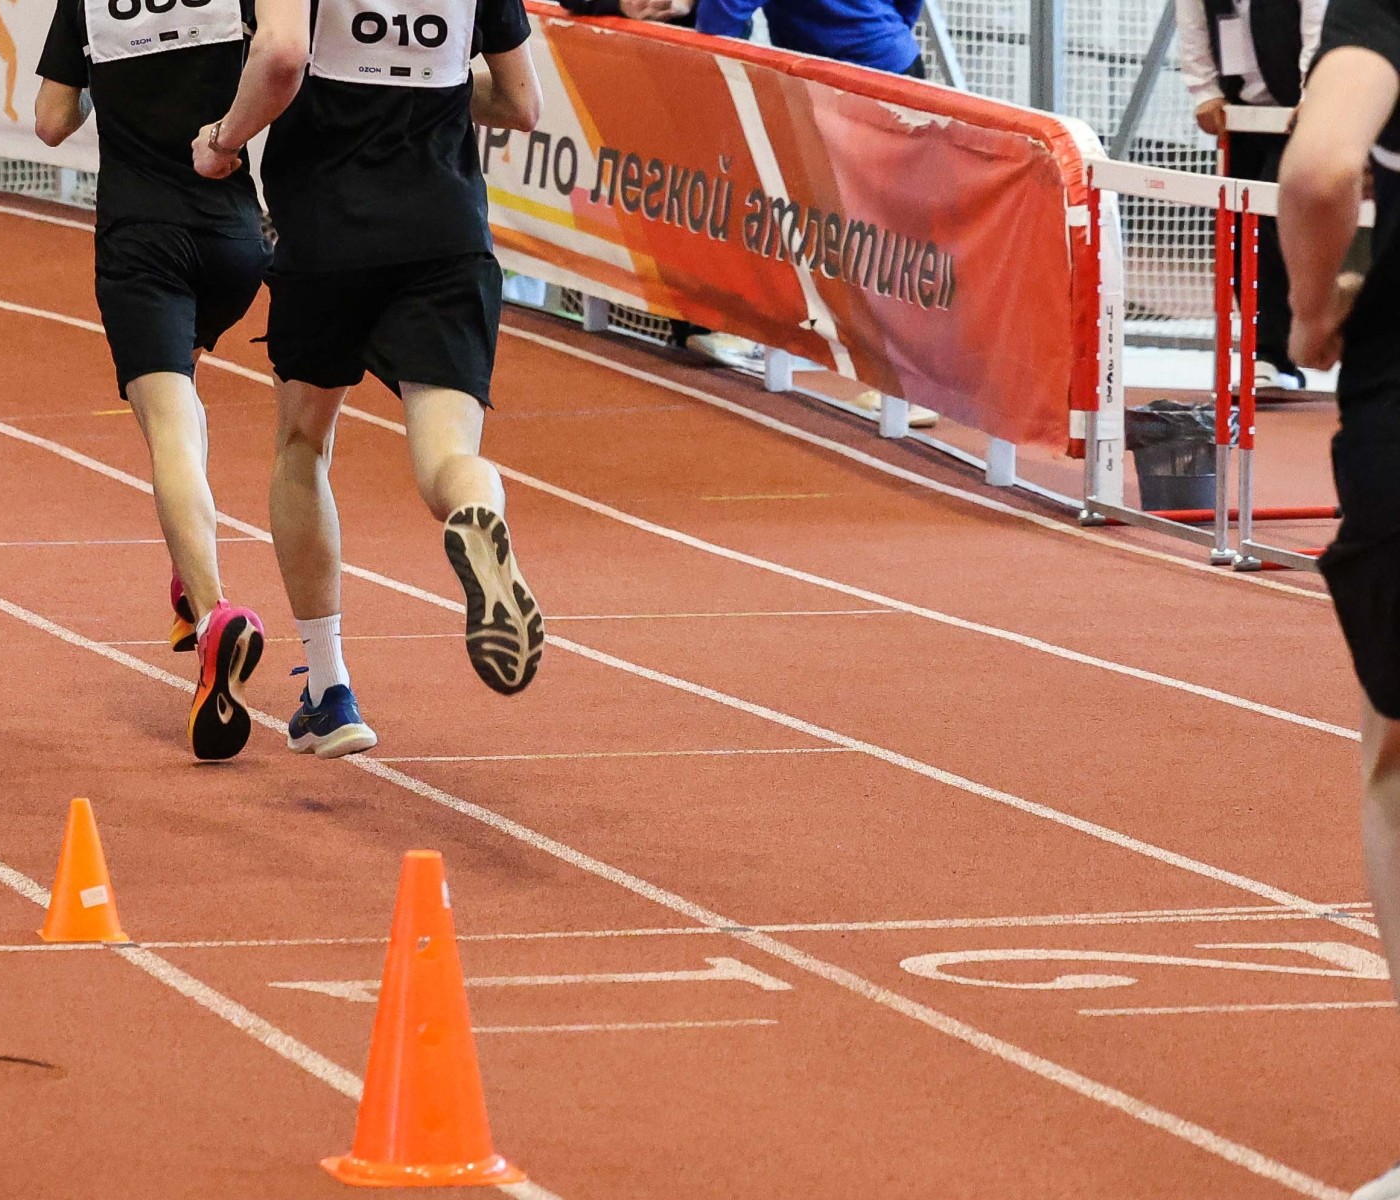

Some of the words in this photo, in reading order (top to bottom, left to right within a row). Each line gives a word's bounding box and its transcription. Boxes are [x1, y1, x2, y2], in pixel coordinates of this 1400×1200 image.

[130, 38, 152, 46] OZON
[351, 11, 448, 48] 010
[589, 146, 735, 242] легкой
